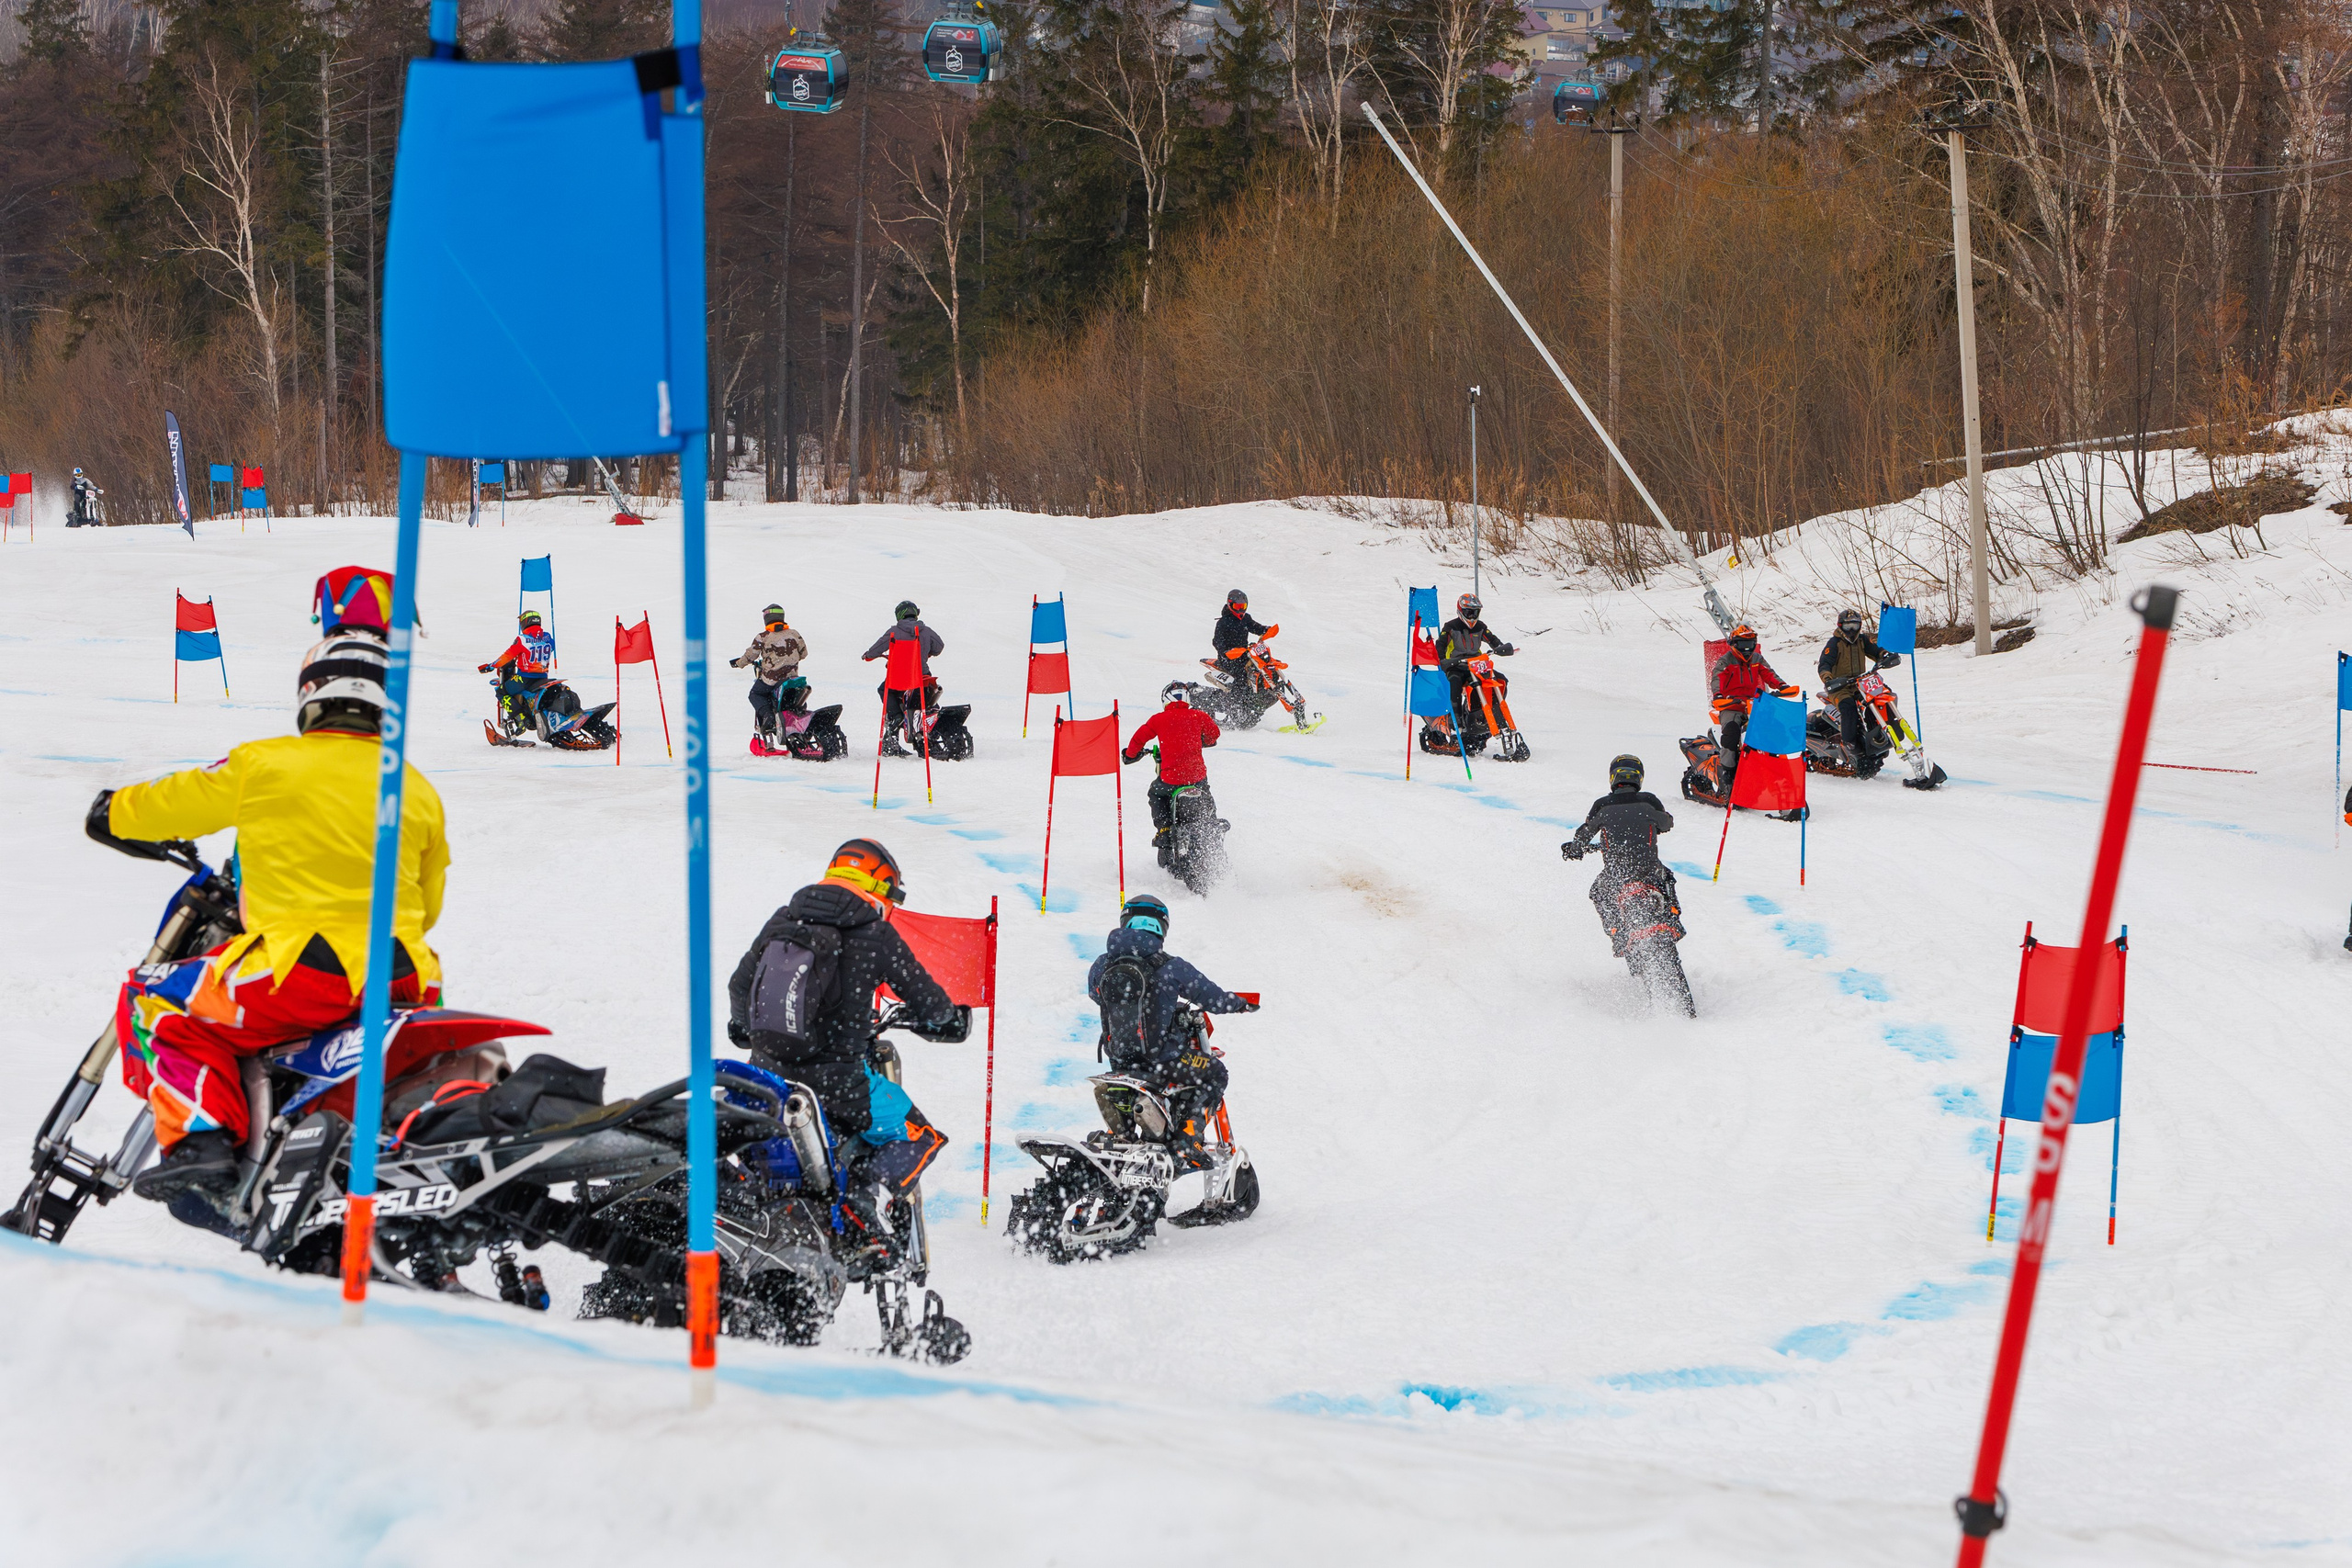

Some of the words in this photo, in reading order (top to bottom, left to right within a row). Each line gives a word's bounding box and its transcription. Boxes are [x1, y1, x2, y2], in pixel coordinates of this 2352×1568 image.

[1696, 570, 1708, 586] 703
[529, 645, 551, 662] 119
[289, 1126, 323, 1141] RIOT
[267, 1183, 459, 1231] TMBRSLED
